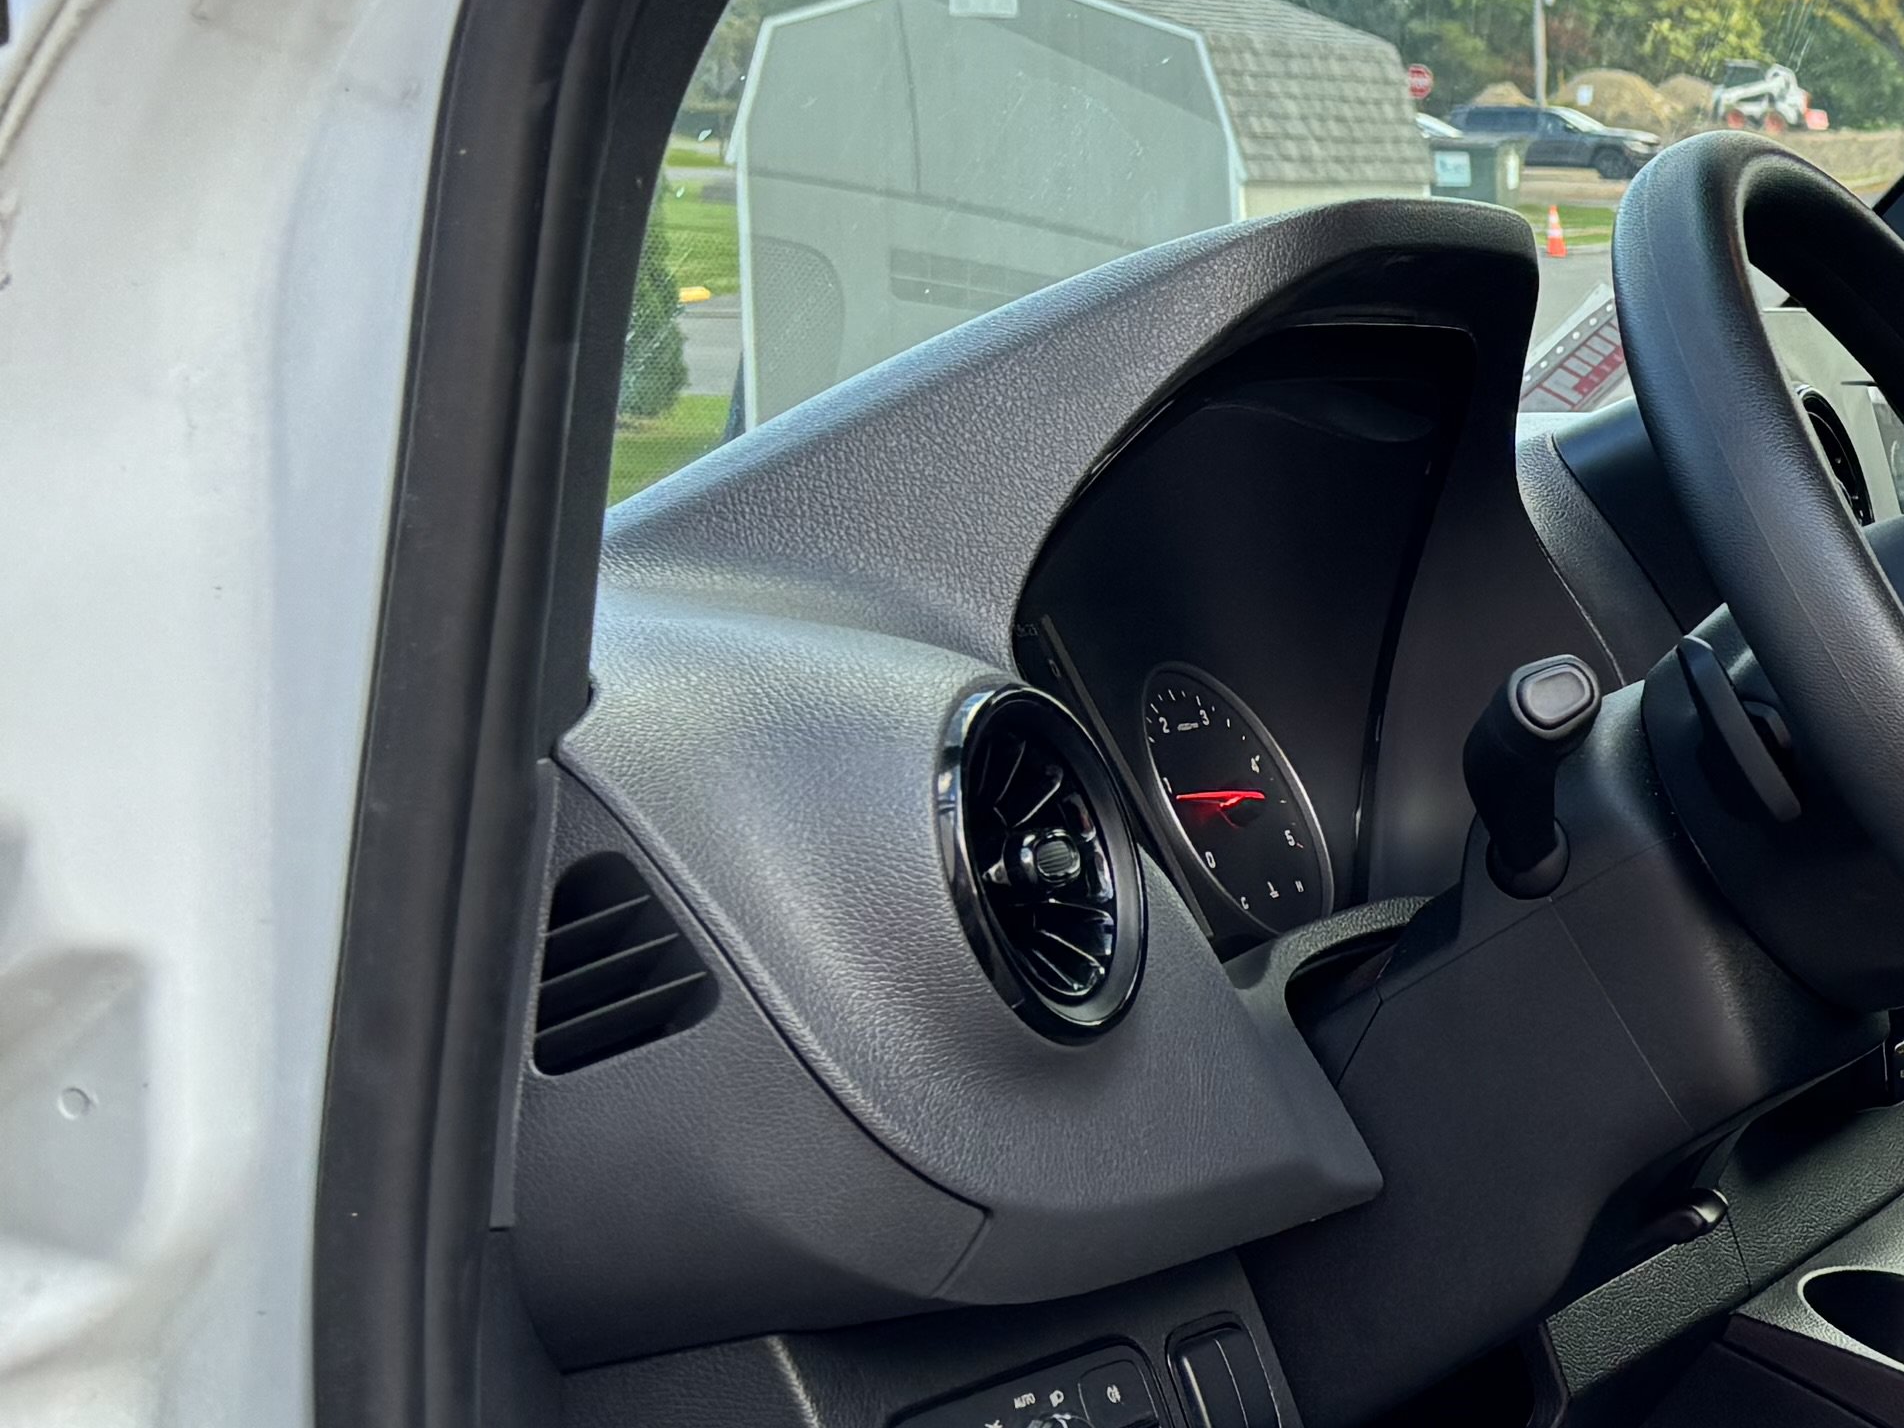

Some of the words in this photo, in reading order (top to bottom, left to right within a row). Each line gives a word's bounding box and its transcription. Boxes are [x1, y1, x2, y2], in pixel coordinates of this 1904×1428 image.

[1159, 717, 1171, 734] 2
[1200, 710, 1210, 726] 3
[1163, 777, 1172, 794] 1
[1284, 830, 1296, 846] 5
[1205, 851, 1217, 869] 0
[1241, 896, 1250, 910] C
[1014, 1392, 1036, 1409] AUTO
